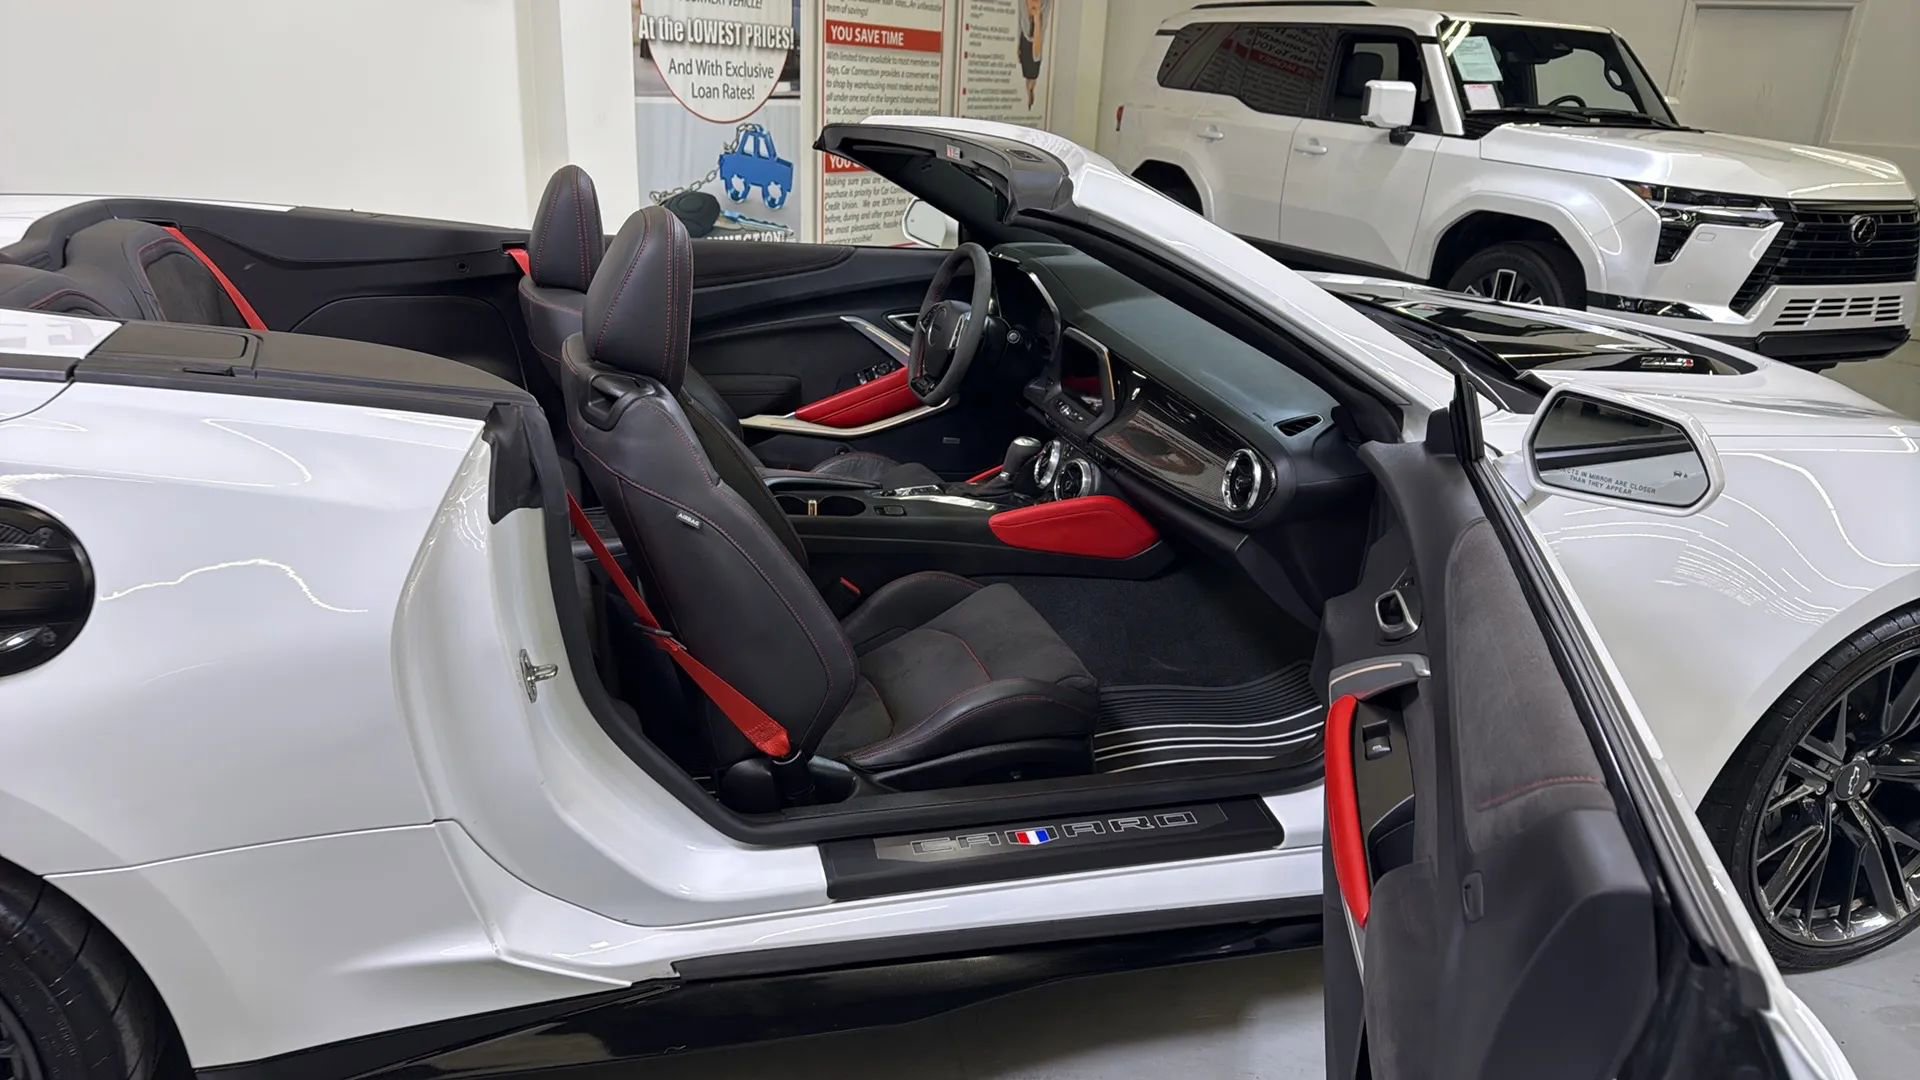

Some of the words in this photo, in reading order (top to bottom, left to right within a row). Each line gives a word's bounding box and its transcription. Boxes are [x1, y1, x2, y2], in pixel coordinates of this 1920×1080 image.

[638, 14, 656, 40] At
[658, 16, 684, 42] the
[687, 18, 743, 46] LOWEST
[745, 24, 795, 50] PRICES!
[830, 25, 853, 41] YOU
[854, 28, 880, 44] SAVE
[881, 31, 904, 46] TIME
[668, 58, 693, 75] And
[695, 59, 722, 76] With
[725, 61, 774, 79] Exclusive
[691, 82, 719, 99] Loan
[722, 84, 755, 100] Rates!
[1569, 475, 1586, 485] THAN
[1587, 477, 1604, 488] THEY
[1605, 483, 1633, 496] APPEAR
[1589, 472, 1613, 484] MIRROR
[1614, 478, 1628, 488] ARE
[1630, 482, 1657, 495] CLOSER
